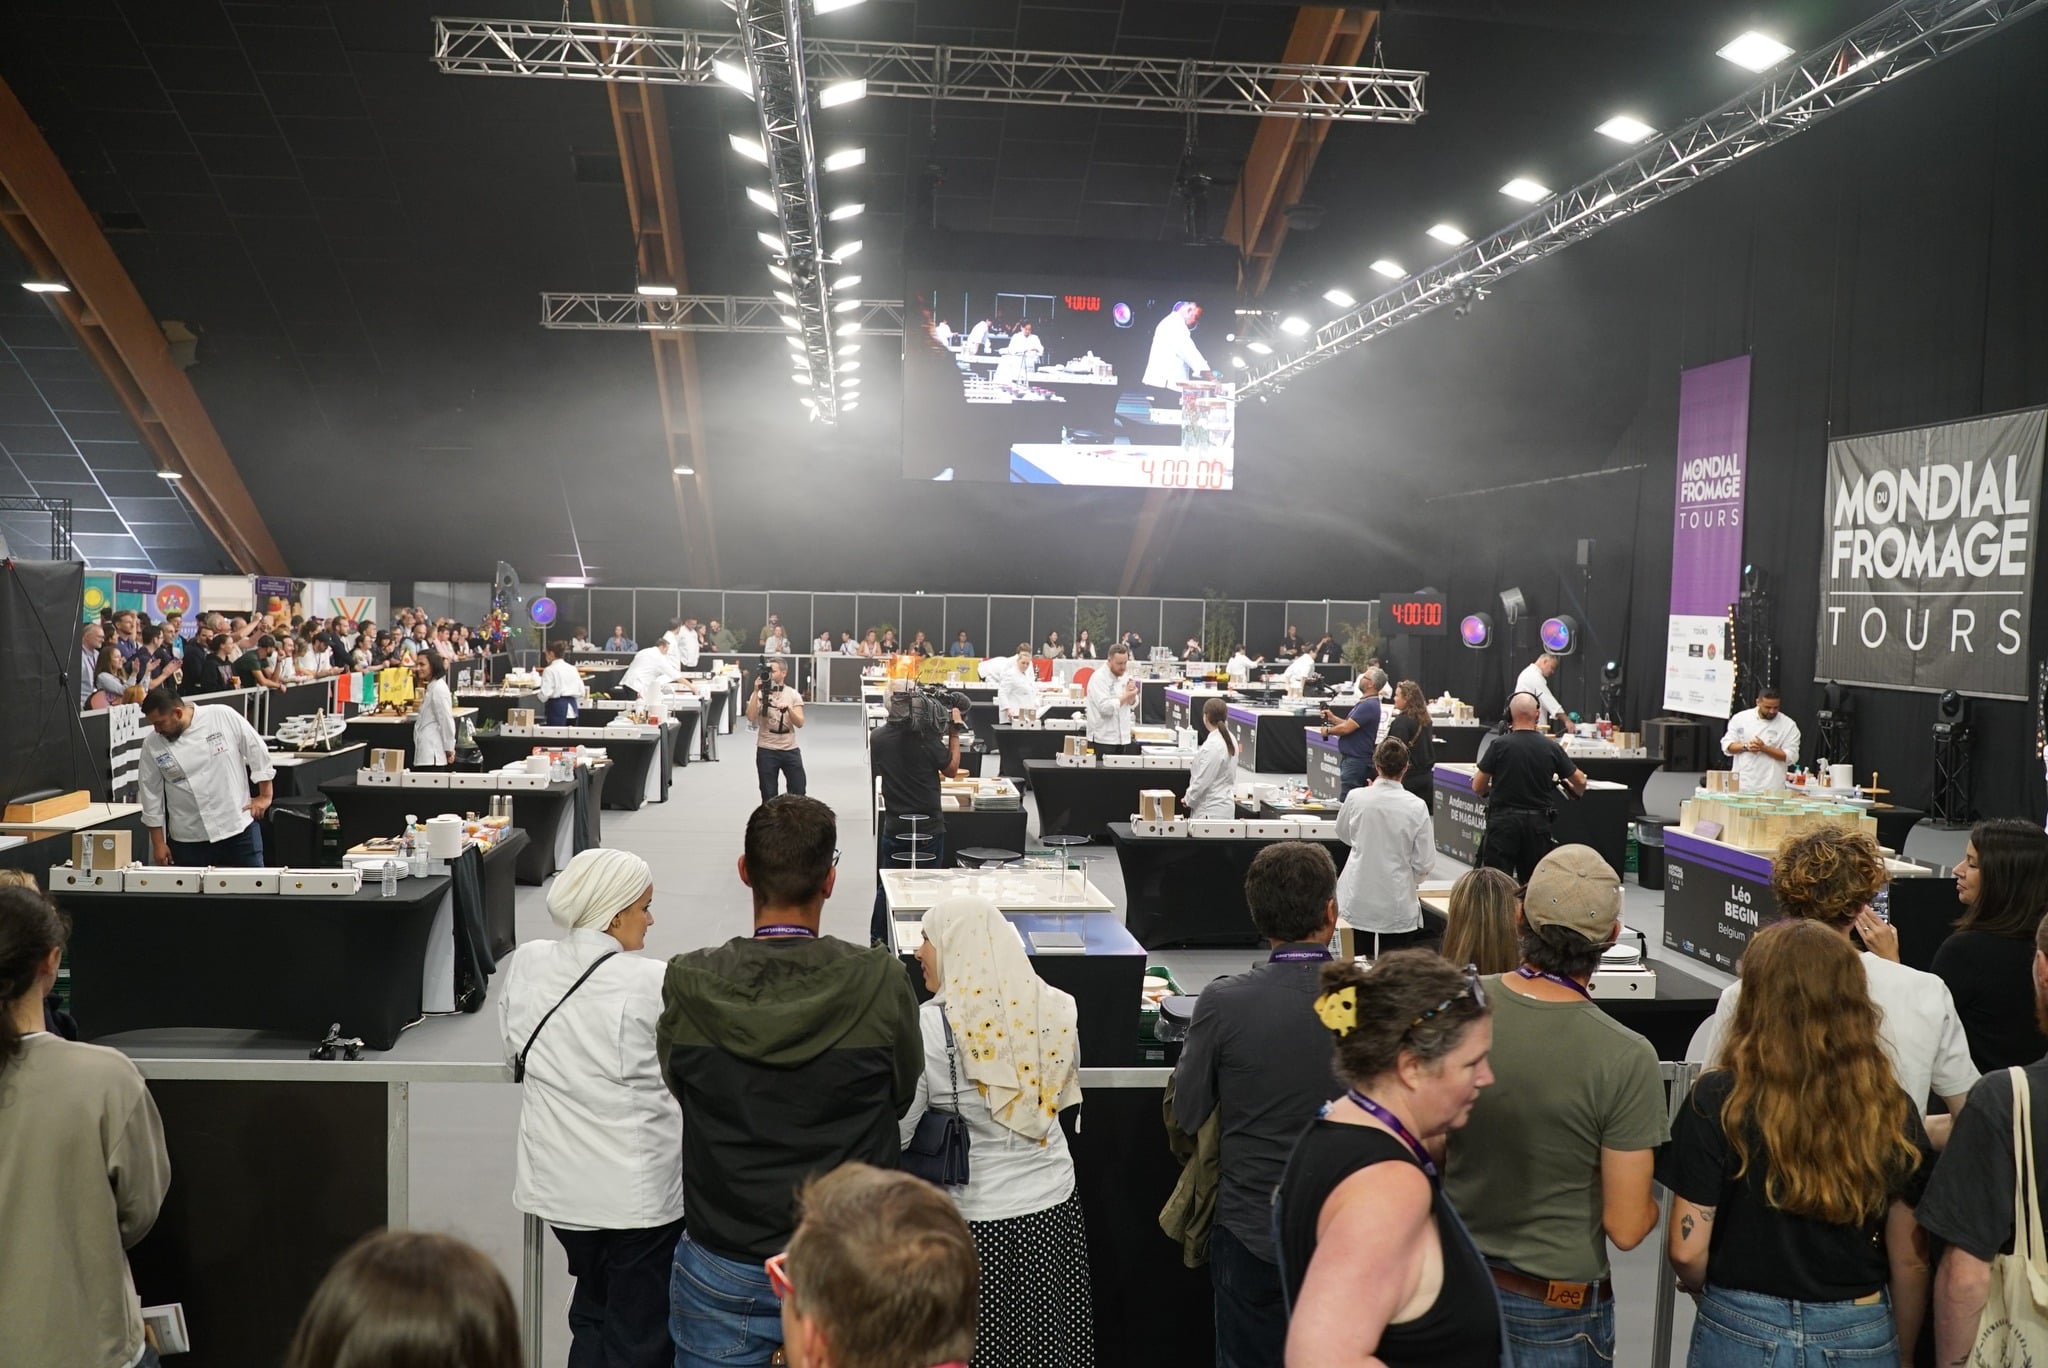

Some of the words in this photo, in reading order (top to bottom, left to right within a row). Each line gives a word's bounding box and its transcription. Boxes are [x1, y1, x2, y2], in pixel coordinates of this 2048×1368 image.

[1681, 453, 1741, 482] MONDIAL
[1680, 476, 1741, 503] FROMAGE
[1834, 454, 2030, 527] MONDIAL
[1876, 491, 1888, 504] DU
[1680, 508, 1739, 529] TOURS
[1831, 518, 2029, 579] FROMAGE
[1391, 602, 1442, 626] 4:00:00
[1828, 606, 2022, 655] TOURS
[1448, 794, 1474, 812] Anderson
[1450, 808, 1459, 821] DE
[1731, 884, 1752, 904] Léo
[1724, 900, 1759, 927] BEGIN
[1718, 921, 1746, 942] Belgium
[1548, 1285, 1580, 1305] Lee
